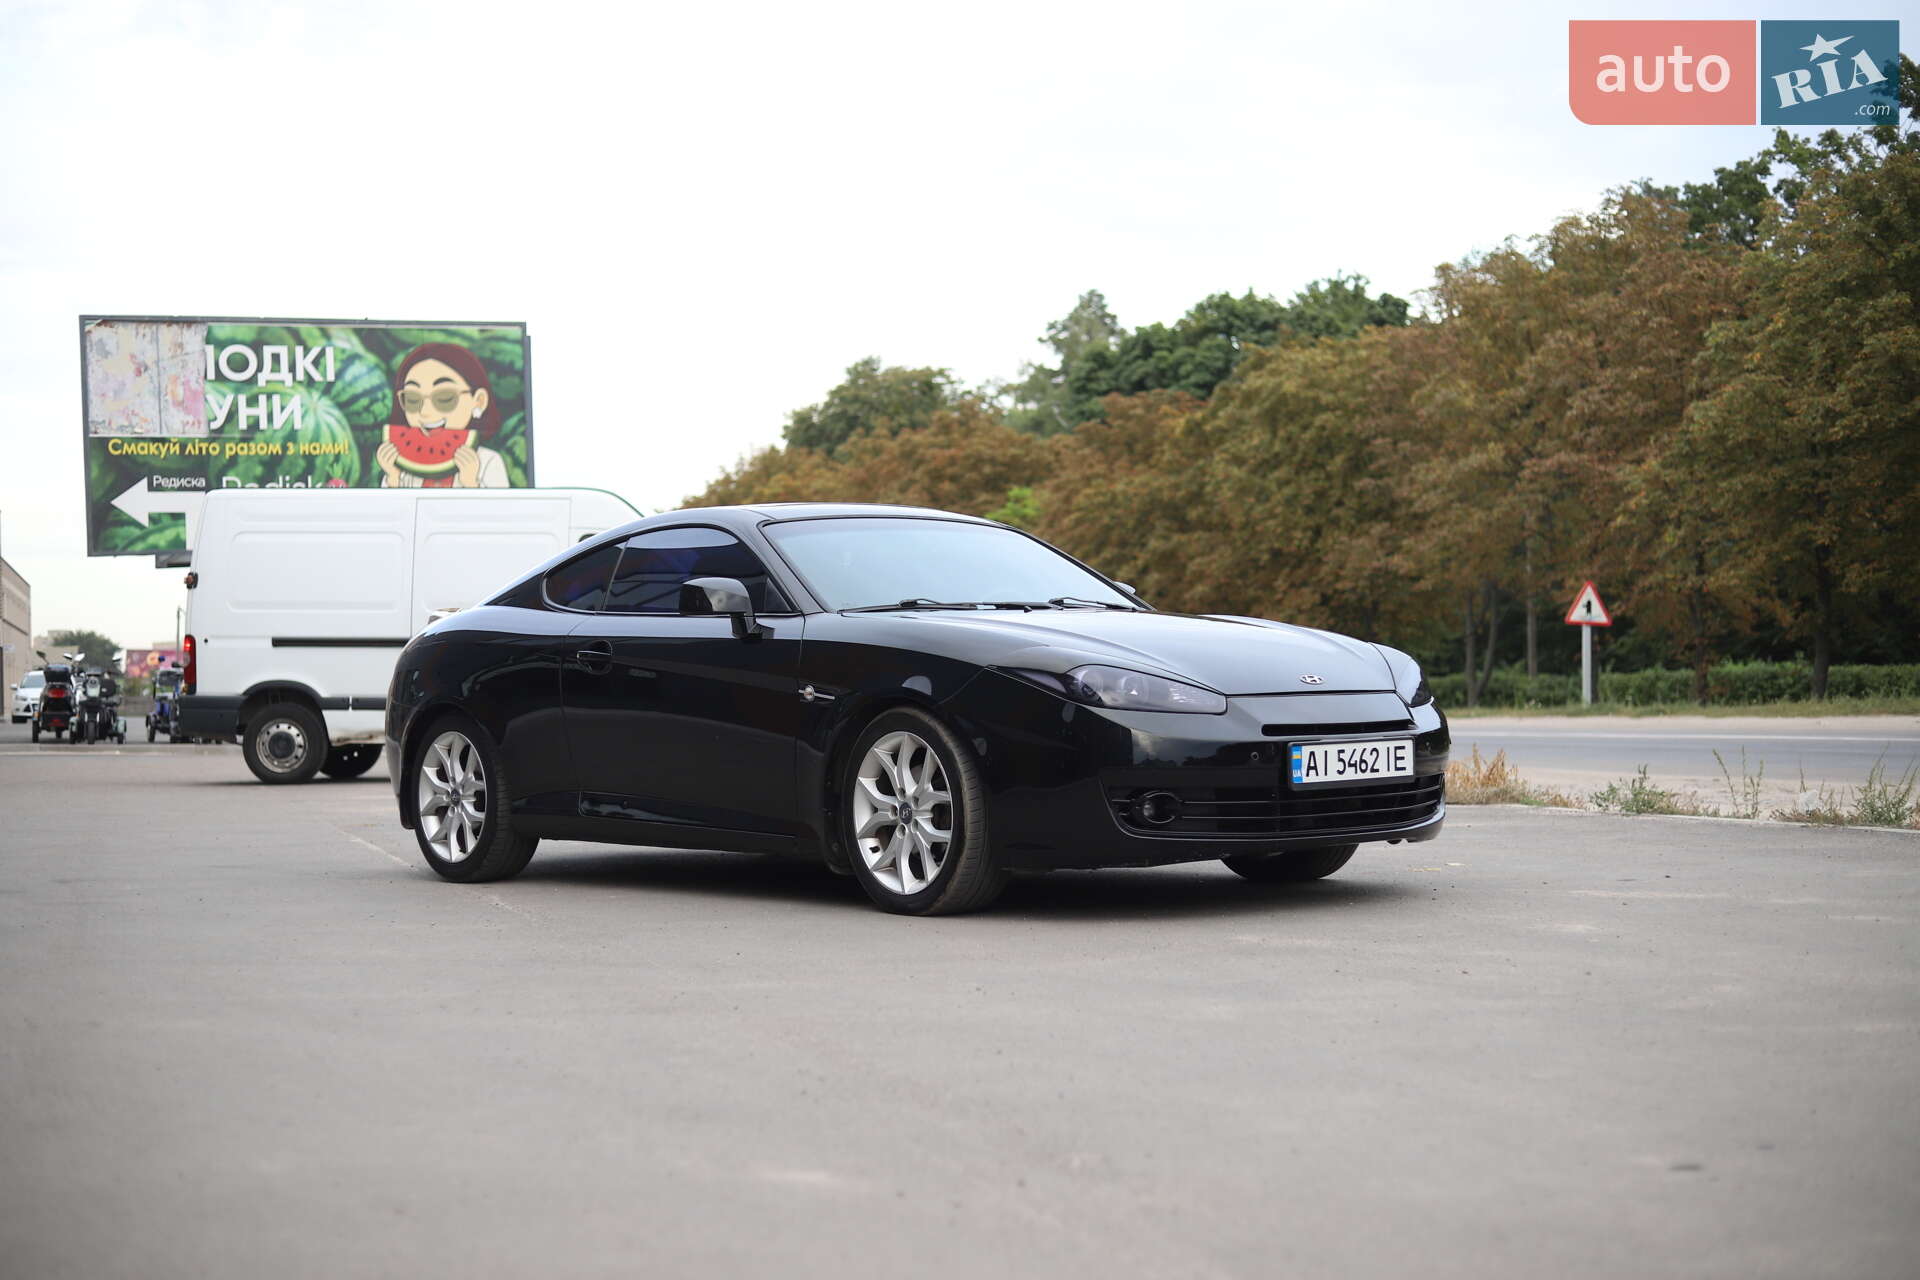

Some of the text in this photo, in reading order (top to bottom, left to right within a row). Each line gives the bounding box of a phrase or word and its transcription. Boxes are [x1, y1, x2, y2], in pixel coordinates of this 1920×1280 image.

[108, 438, 349, 458] Смакуй літо разом з нами!
[153, 475, 206, 489] Редиска
[1306, 745, 1407, 777] AI 5462 IE
[1292, 769, 1302, 778] UA
